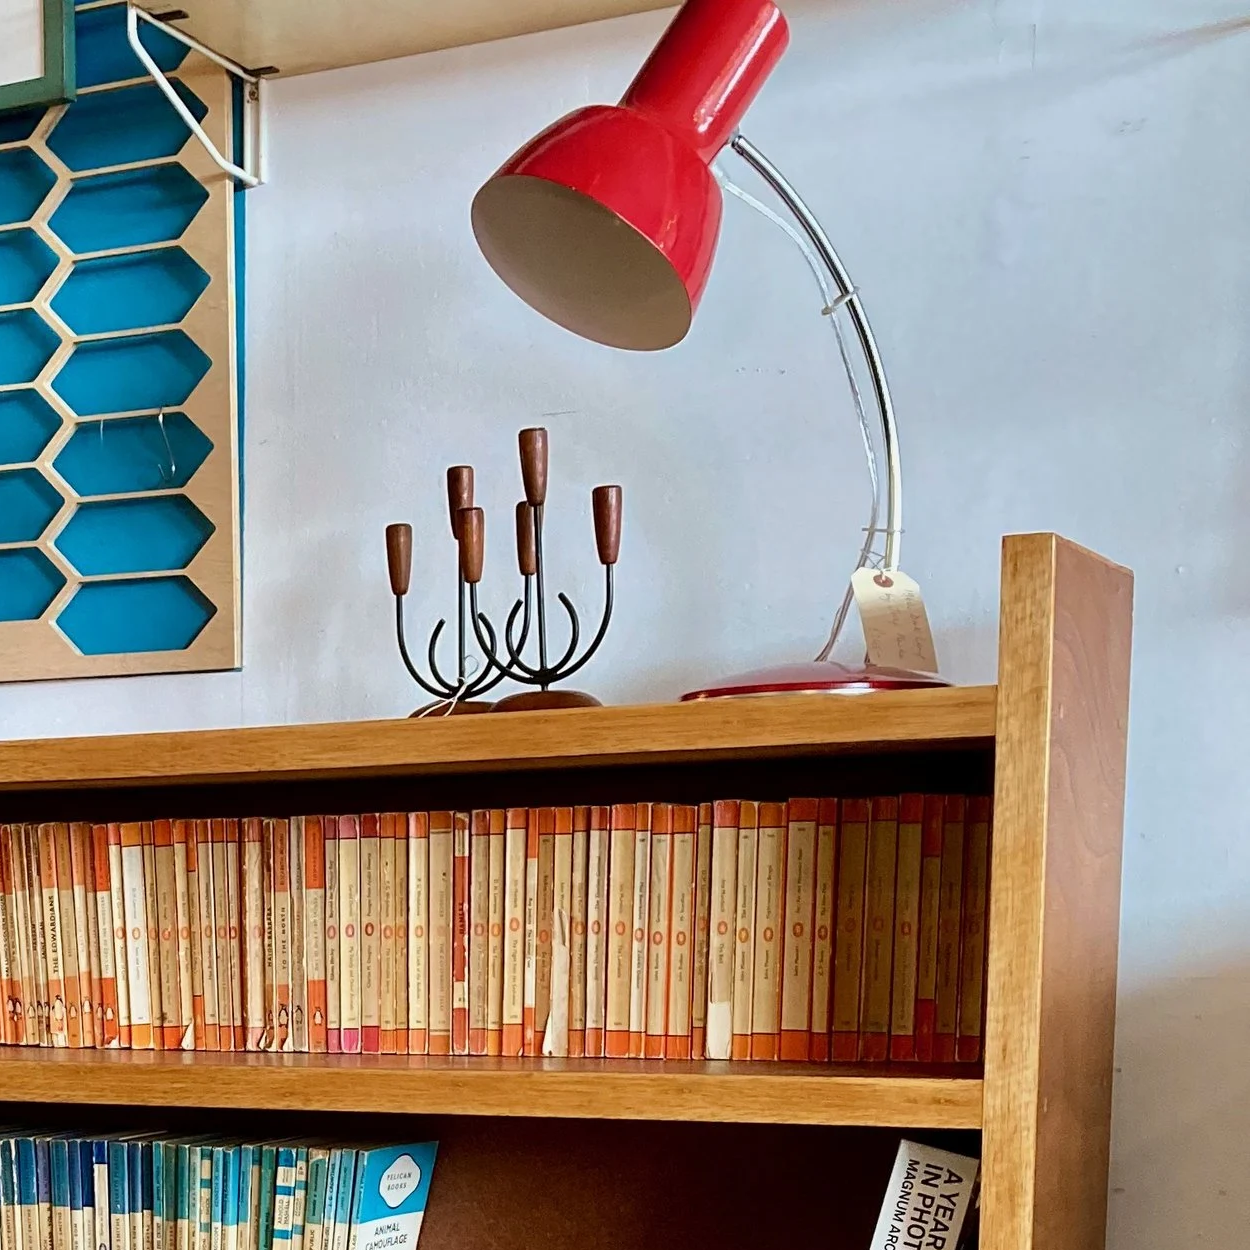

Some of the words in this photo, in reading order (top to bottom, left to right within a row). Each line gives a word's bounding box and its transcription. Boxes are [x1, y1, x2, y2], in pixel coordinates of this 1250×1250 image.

[48, 896, 58, 953] EDWARDIANS
[386, 1172, 412, 1182] PELICAN
[920, 1163, 945, 1189] IN
[946, 1168, 964, 1186] A
[387, 1182, 408, 1191] BOOKS
[892, 1158, 921, 1223] MAGNUM
[373, 1220, 401, 1236] ANIMAL
